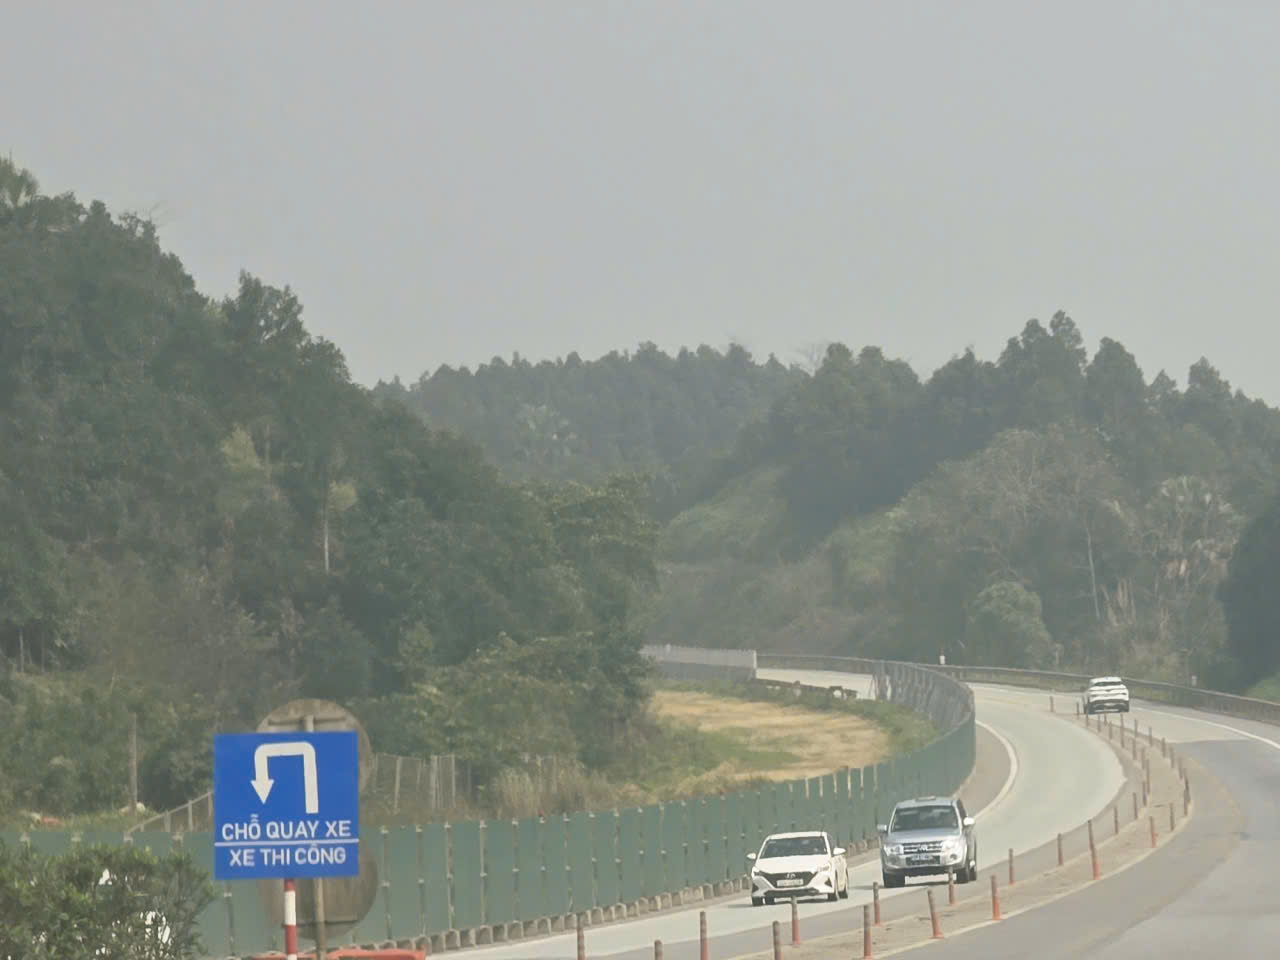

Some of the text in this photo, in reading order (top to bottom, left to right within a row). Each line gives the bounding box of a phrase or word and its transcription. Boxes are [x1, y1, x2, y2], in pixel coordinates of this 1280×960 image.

[222, 813, 352, 841] CHỖ QUAY XE
[229, 842, 347, 867] XE THI CÔNG
